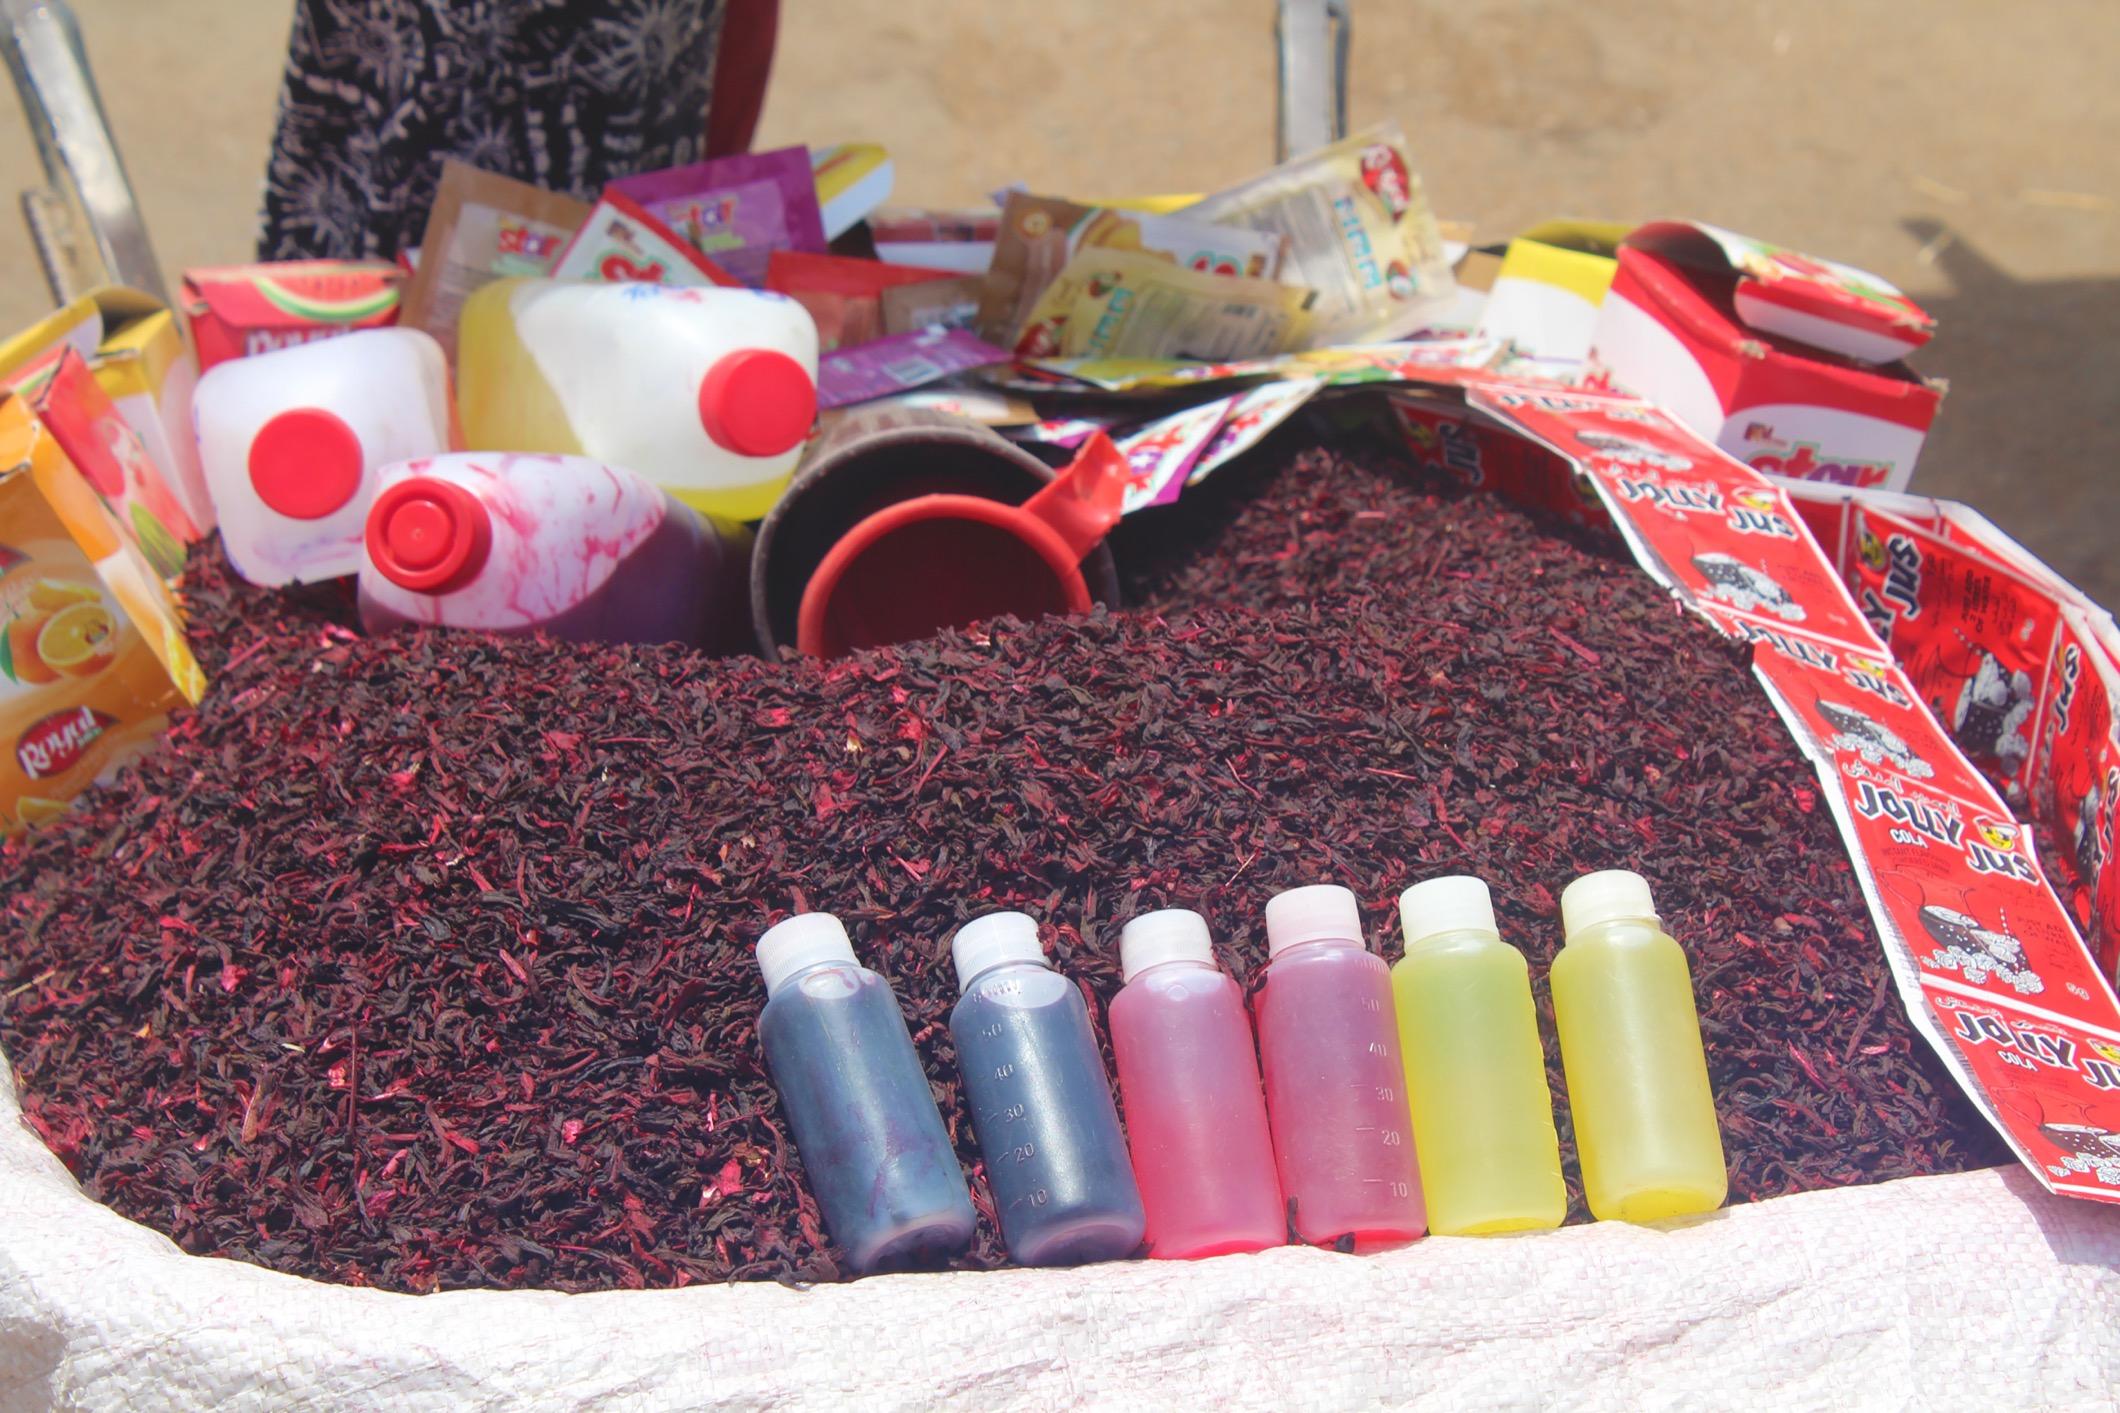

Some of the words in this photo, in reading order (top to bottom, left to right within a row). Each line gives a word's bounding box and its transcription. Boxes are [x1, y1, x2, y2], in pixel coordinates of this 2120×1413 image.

[1883, 532, 1922, 620] JUS
[19, 704, 97, 781] Royal
[1854, 779, 1966, 850] JOLLY
[1964, 837, 2041, 887] JUS
[1888, 828, 1929, 849] COLA
[1954, 1010, 2080, 1072] JOLLY
[1997, 1050, 2039, 1072] COLA
[1375, 1086, 1393, 1102] 30
[1003, 1103, 1024, 1124] 30
[1381, 1129, 1401, 1147] 20
[1015, 1142, 1035, 1164] 20
[1027, 1188, 1047, 1209] 10
[1389, 1181, 1408, 1198] 10
